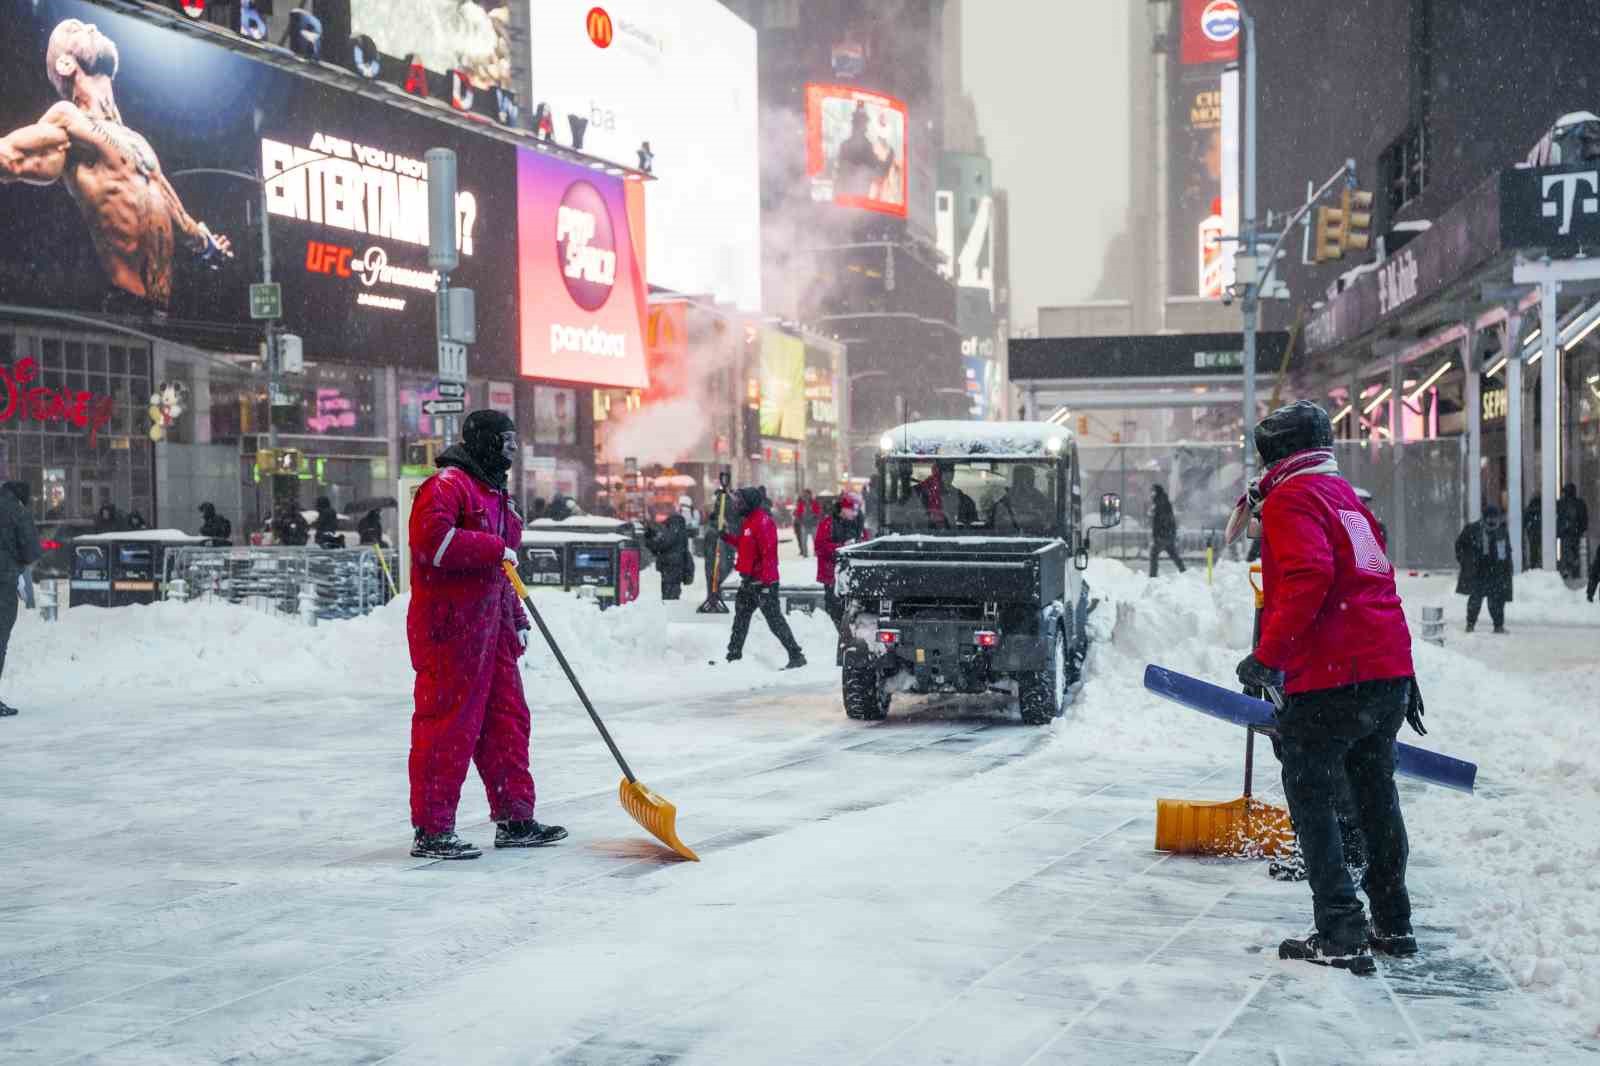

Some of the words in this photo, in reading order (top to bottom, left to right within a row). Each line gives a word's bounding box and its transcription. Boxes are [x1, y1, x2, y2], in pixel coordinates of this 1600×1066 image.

[309, 132, 353, 158] ARE
[352, 143, 394, 171] YOU
[305, 240, 353, 279] UFC
[550, 323, 625, 358] pandora
